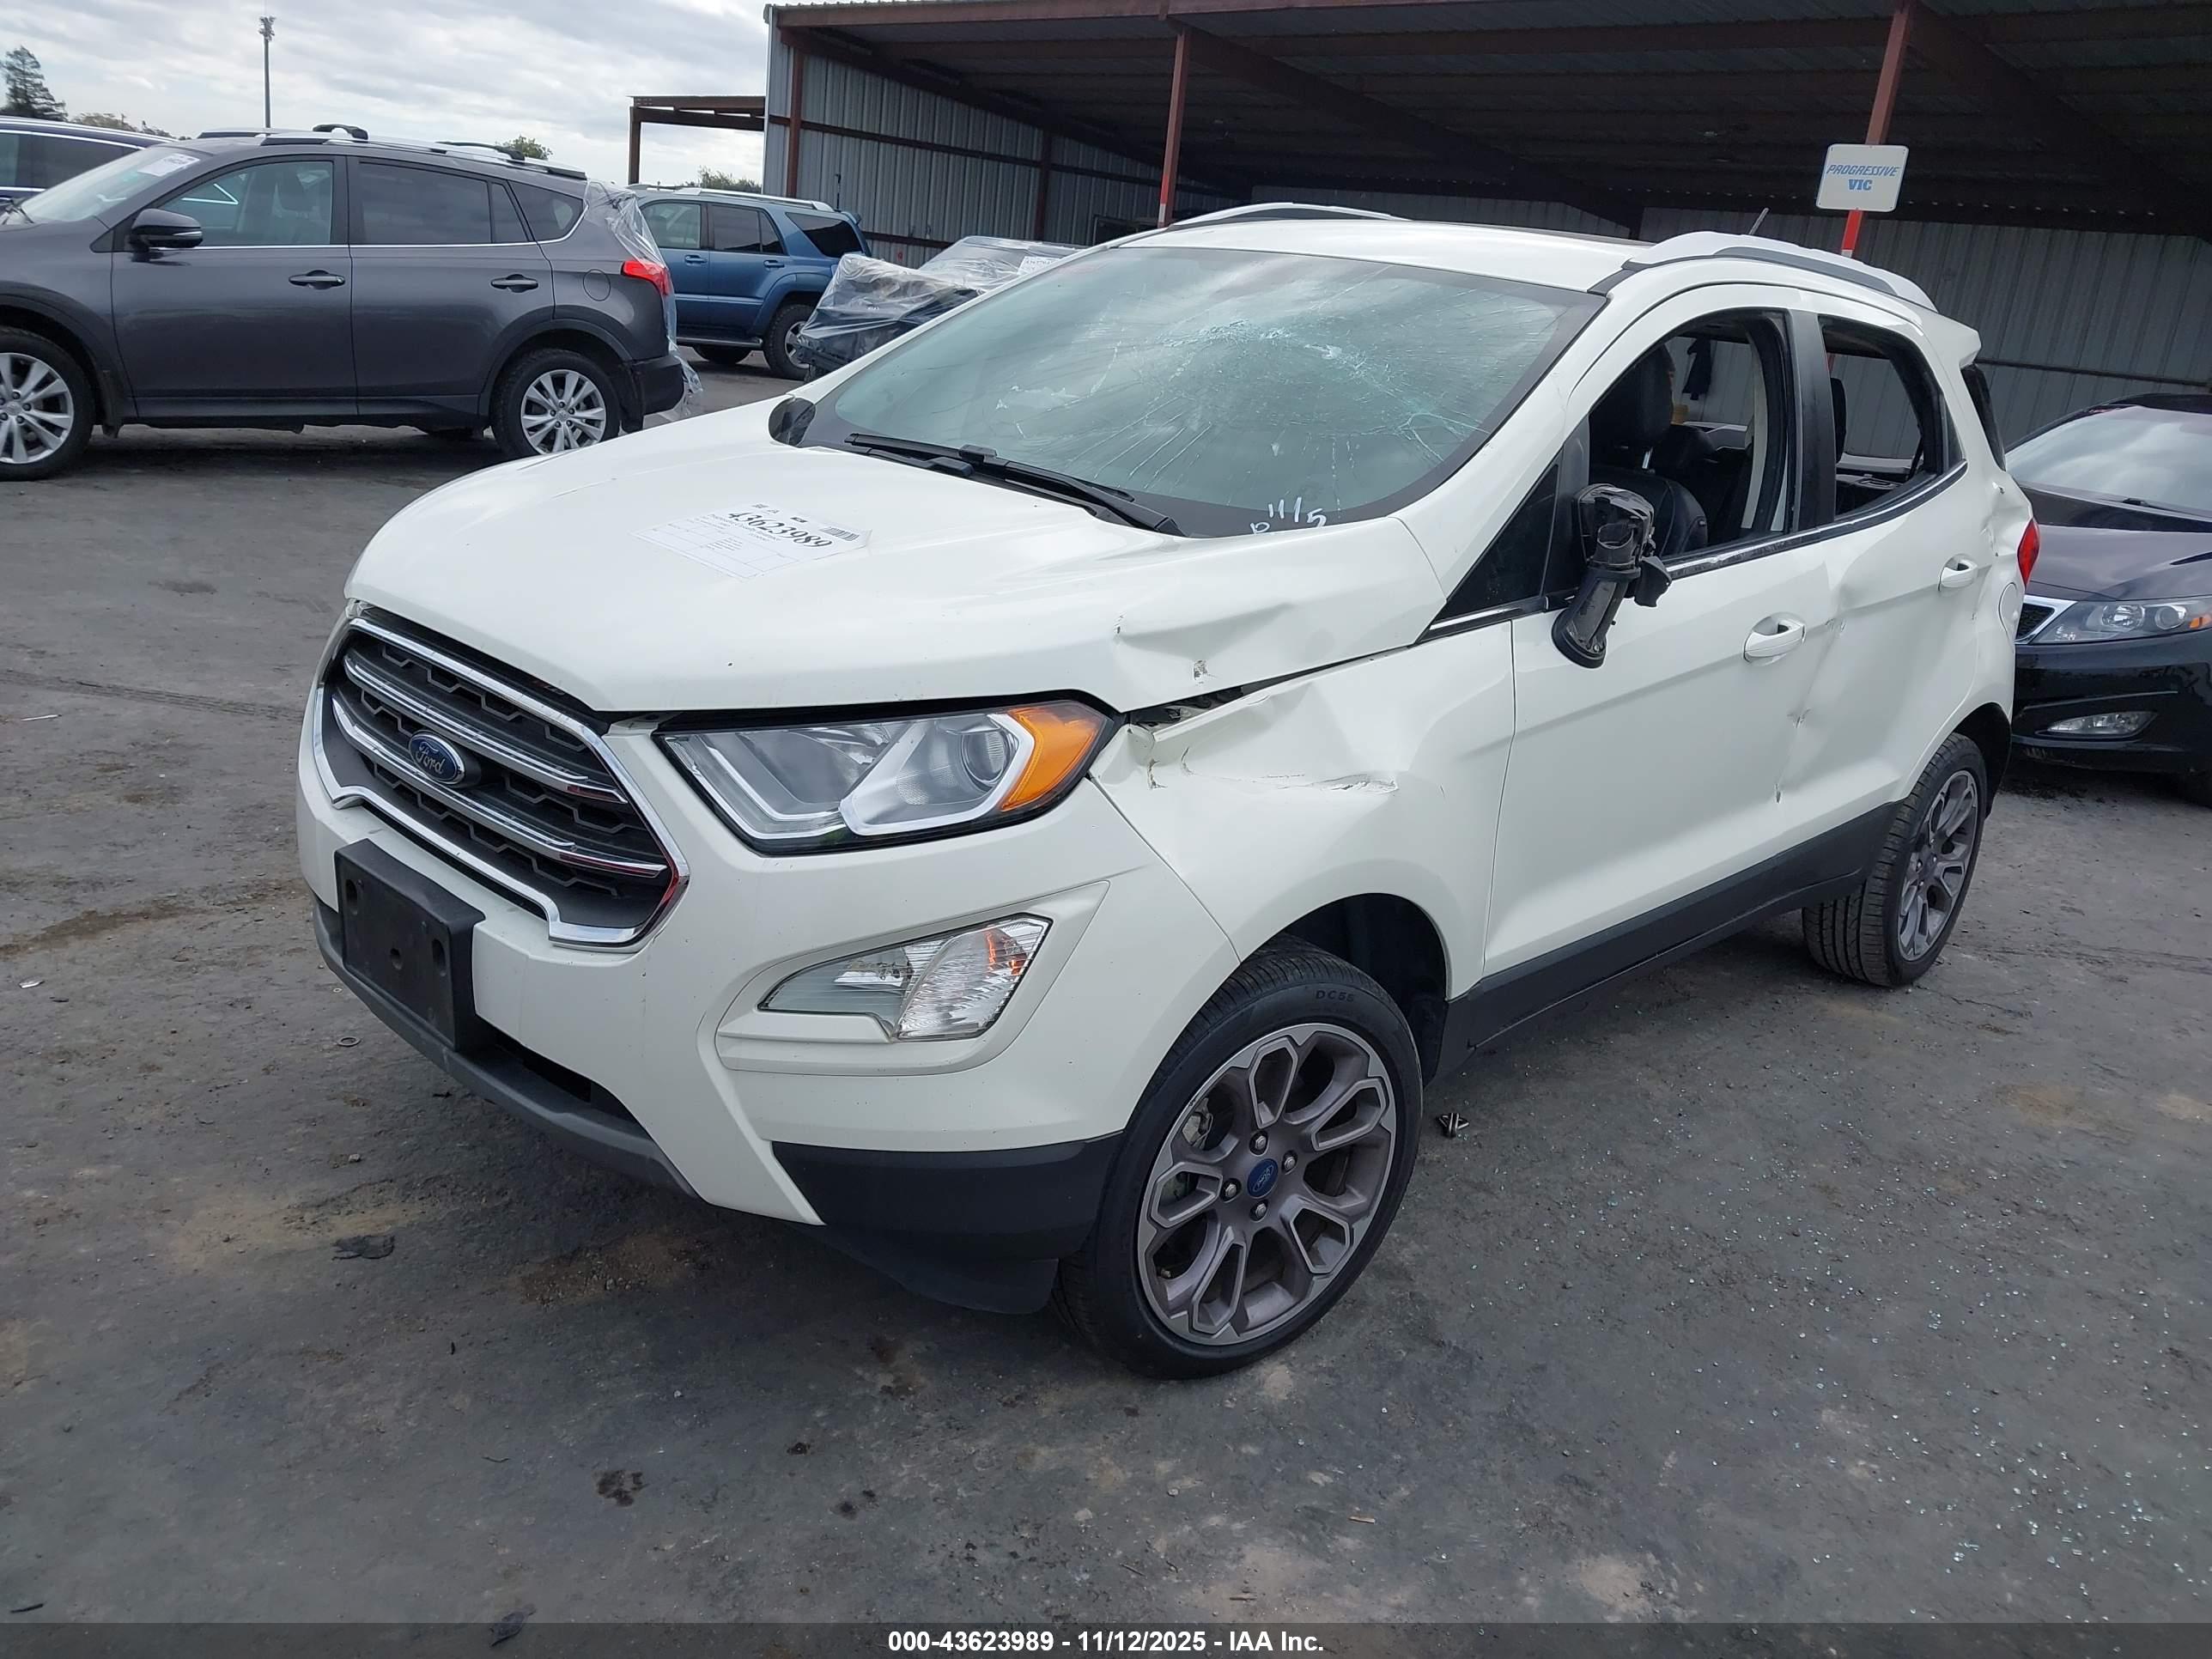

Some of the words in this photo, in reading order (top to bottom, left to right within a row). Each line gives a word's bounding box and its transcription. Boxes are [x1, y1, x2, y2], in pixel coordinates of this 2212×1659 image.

[1826, 164, 1901, 176] PROGRESSIVE
[1848, 179, 1873, 191] VIC
[727, 511, 833, 548] 43623989
[416, 741, 446, 774] Ford
